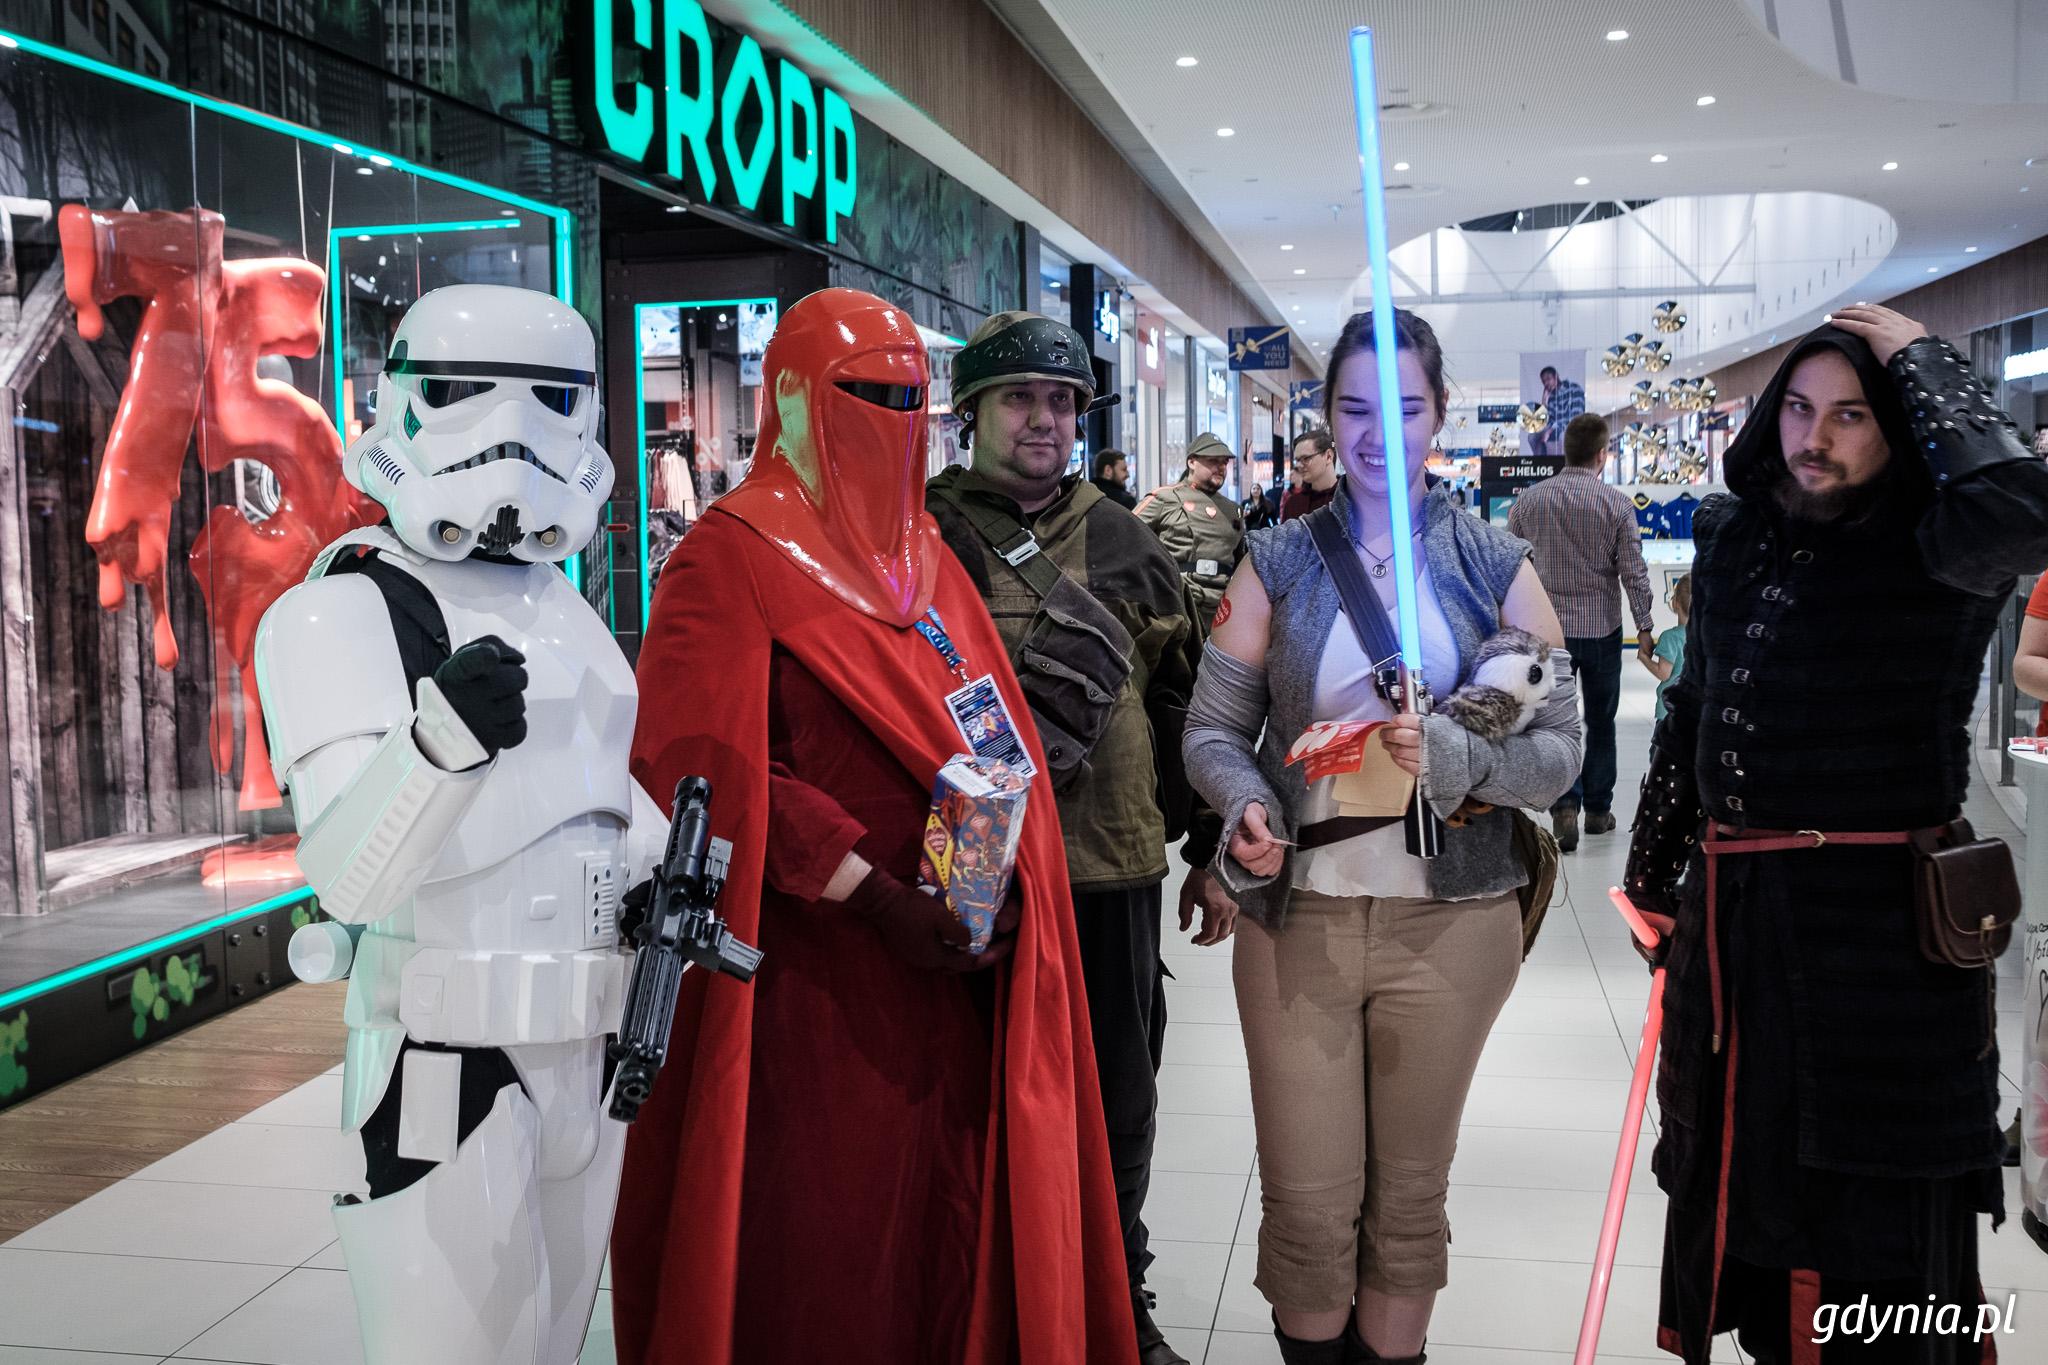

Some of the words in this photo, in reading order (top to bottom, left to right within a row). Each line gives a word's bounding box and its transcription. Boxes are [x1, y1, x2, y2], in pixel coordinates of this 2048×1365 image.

[594, 0, 857, 245] CROPP
[1271, 343, 1286, 352] ALL
[1264, 351, 1286, 360] YOU
[1516, 466, 1554, 477] HELIOS
